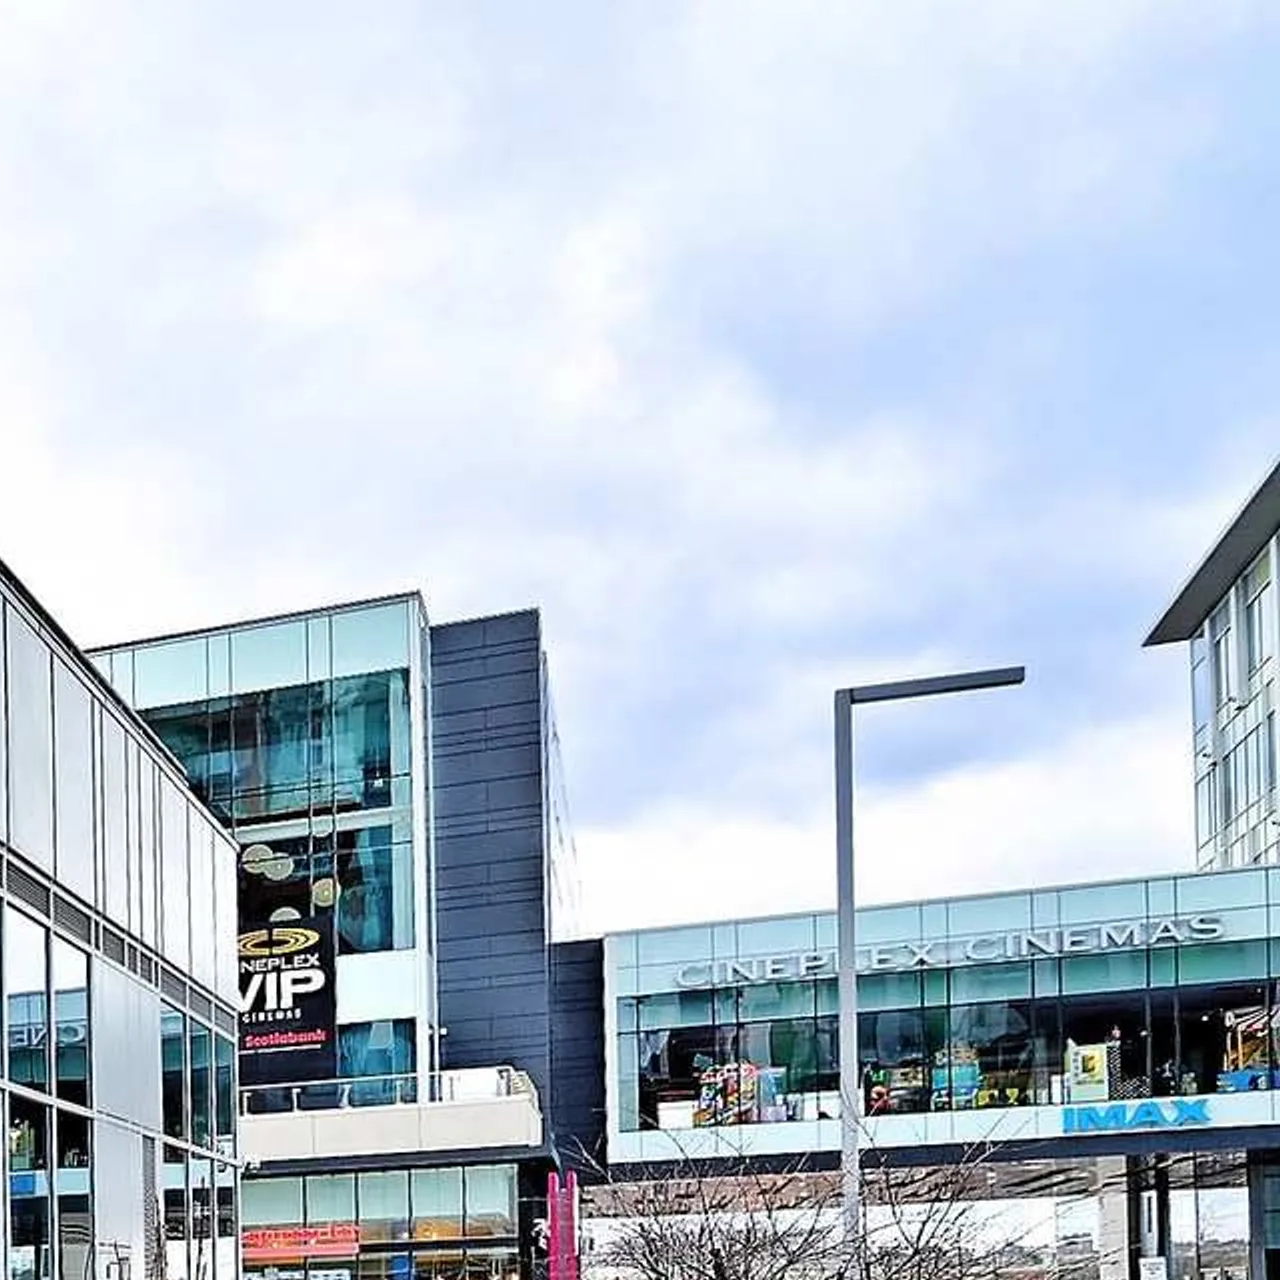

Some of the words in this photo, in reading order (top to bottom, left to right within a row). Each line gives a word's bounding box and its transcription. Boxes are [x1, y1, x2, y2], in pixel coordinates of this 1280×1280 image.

[966, 915, 1224, 960] CINEMAS
[238, 953, 321, 973] NEPLEX
[239, 968, 325, 1012] VIP
[245, 1028, 327, 1048] Scotiabank
[1062, 1099, 1212, 1134] IMAX
